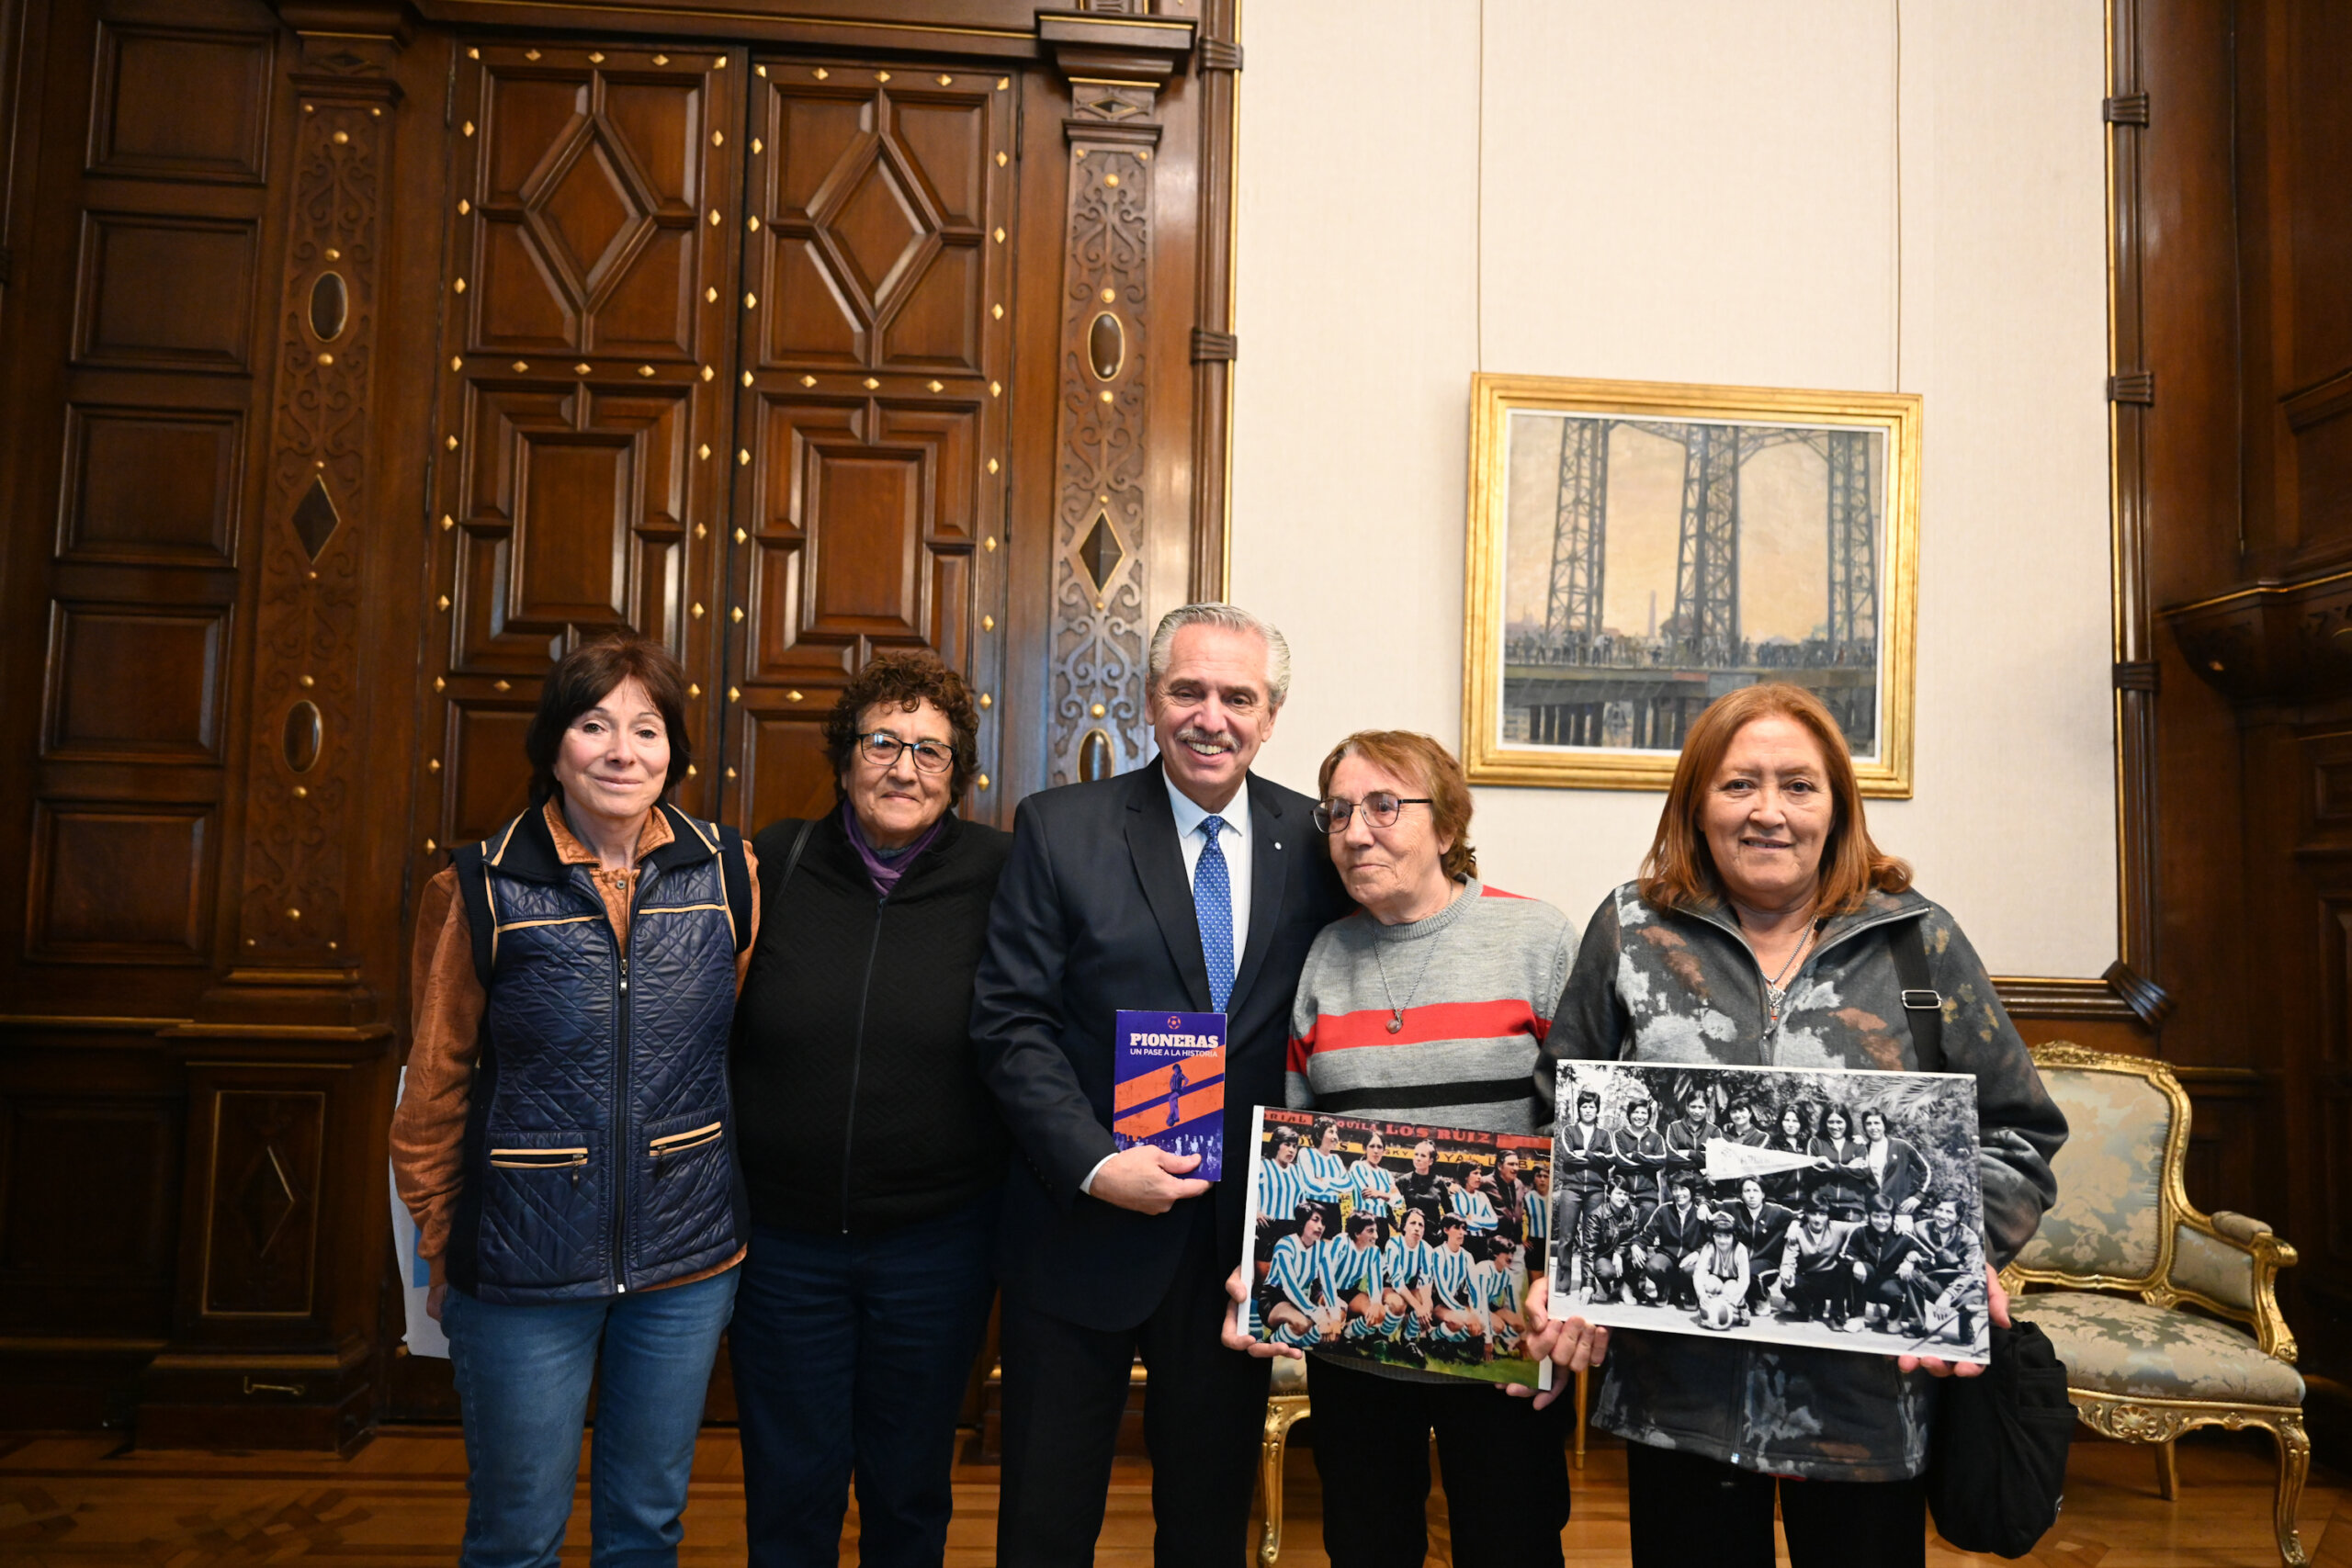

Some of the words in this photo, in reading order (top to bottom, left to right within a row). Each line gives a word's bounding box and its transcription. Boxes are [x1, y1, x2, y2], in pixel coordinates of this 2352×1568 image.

[1130, 1032, 1219, 1048] PIONERAS
[1385, 1123, 1429, 1138] LOS
[1437, 1129, 1491, 1144] RUIZ
